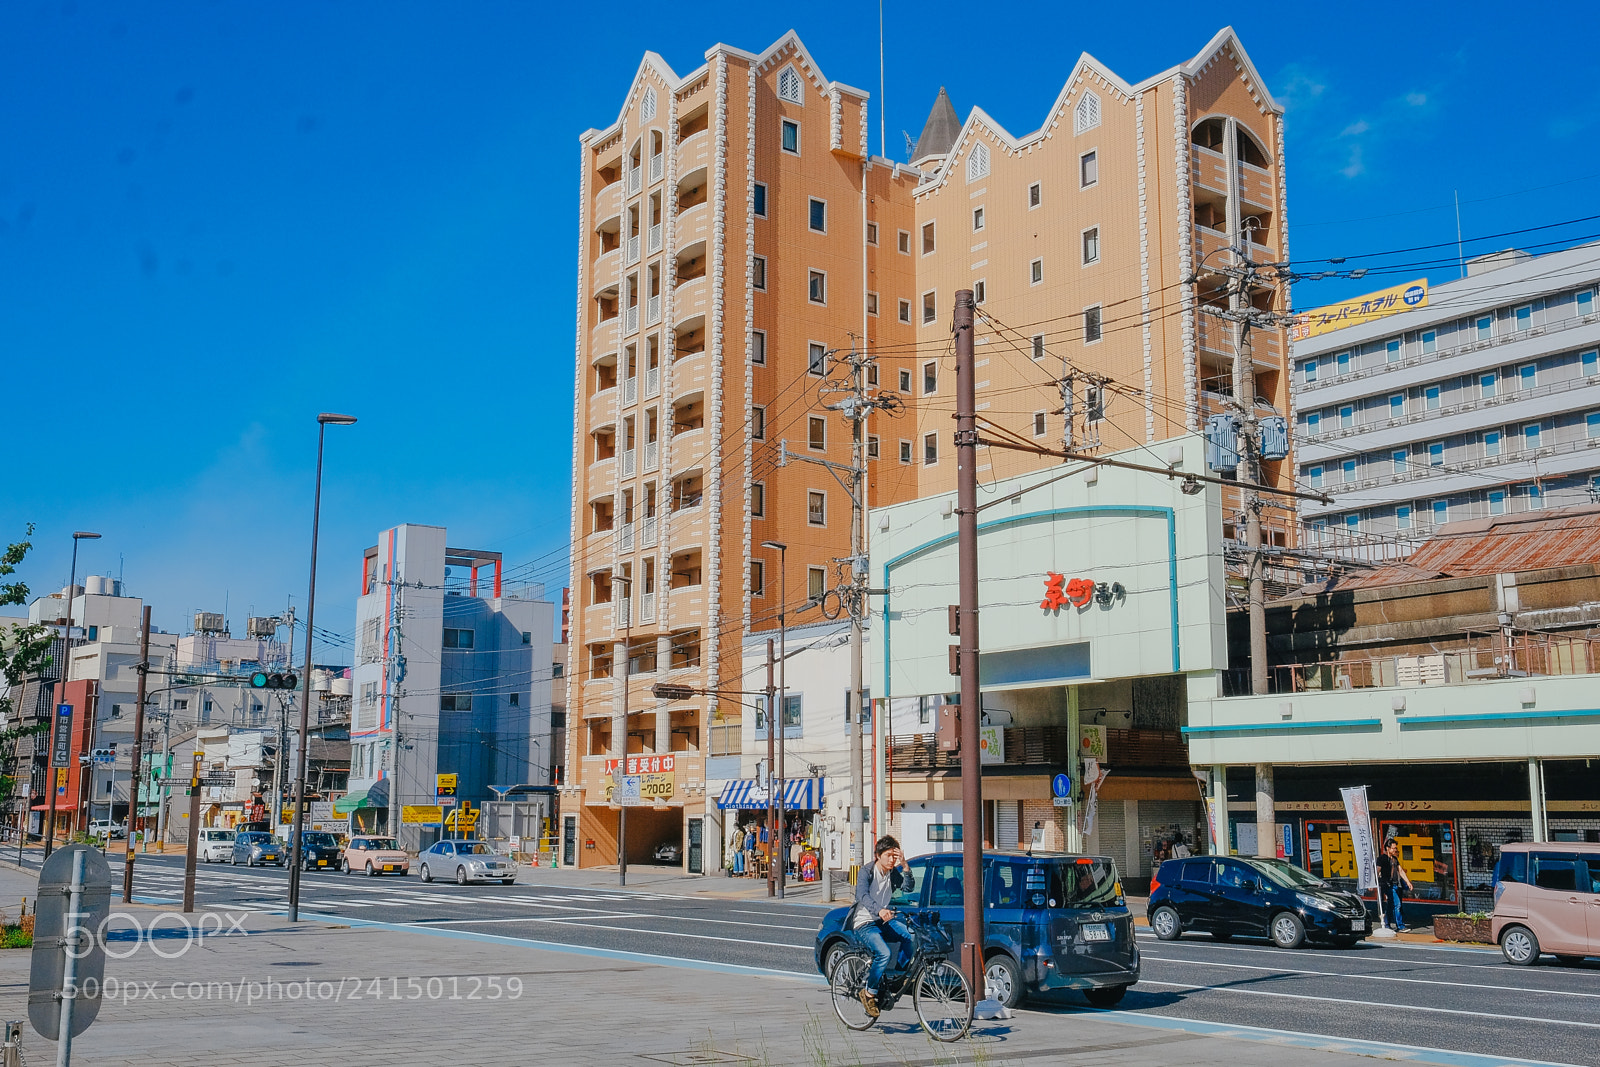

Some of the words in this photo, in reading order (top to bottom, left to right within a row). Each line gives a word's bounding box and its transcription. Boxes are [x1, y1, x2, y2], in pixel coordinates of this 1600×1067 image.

[1316, 294, 1398, 327] スーパーホテル
[61, 706, 68, 715] P
[438, 787, 444, 795] P
[641, 783, 672, 794] -7002
